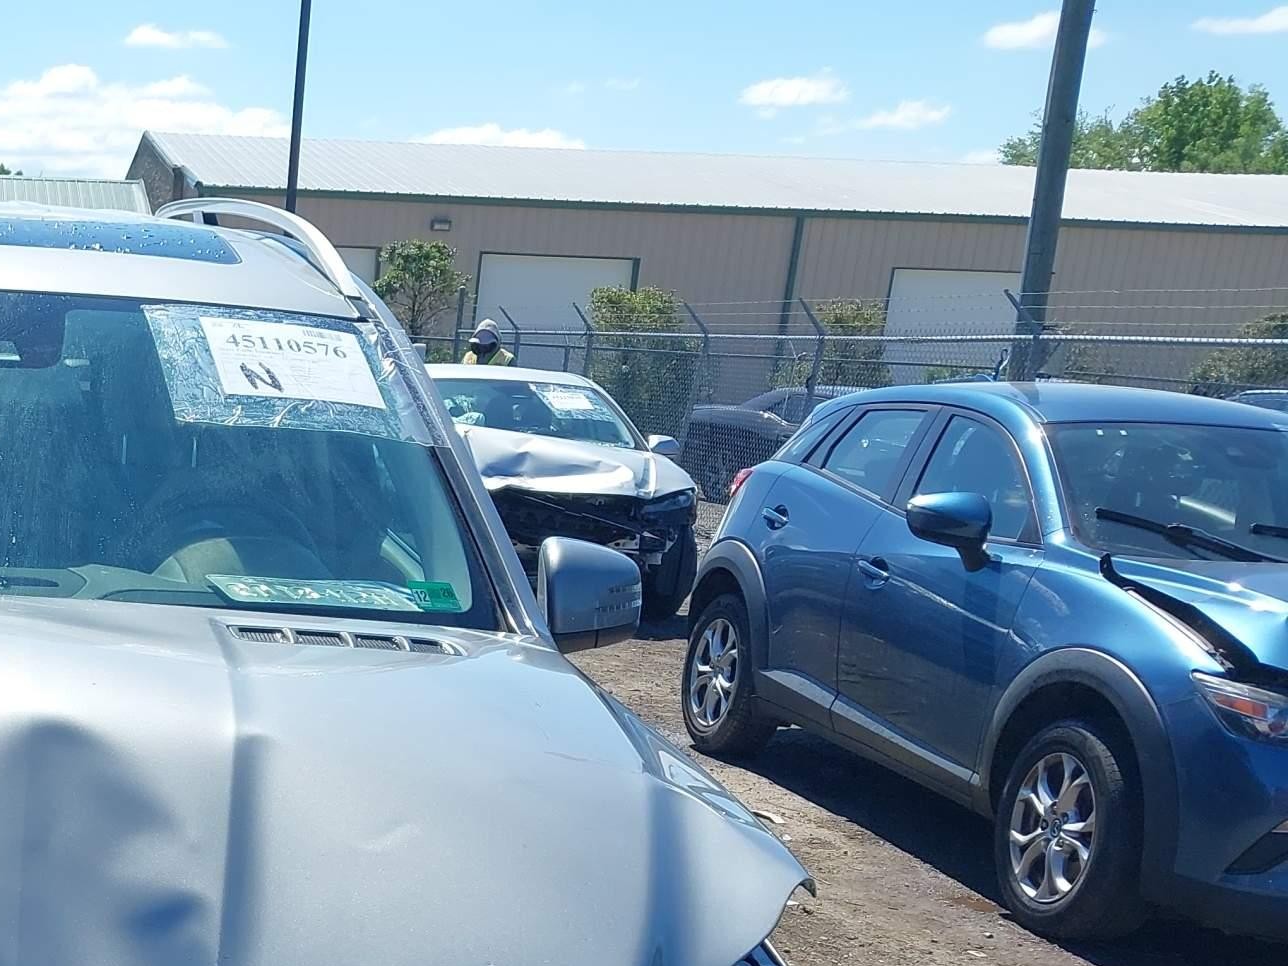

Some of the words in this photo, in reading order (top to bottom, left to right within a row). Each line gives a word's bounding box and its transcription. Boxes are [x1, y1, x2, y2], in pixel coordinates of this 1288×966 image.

[225, 333, 347, 359] 45110576
[239, 362, 285, 393] N
[413, 590, 431, 603] 12
